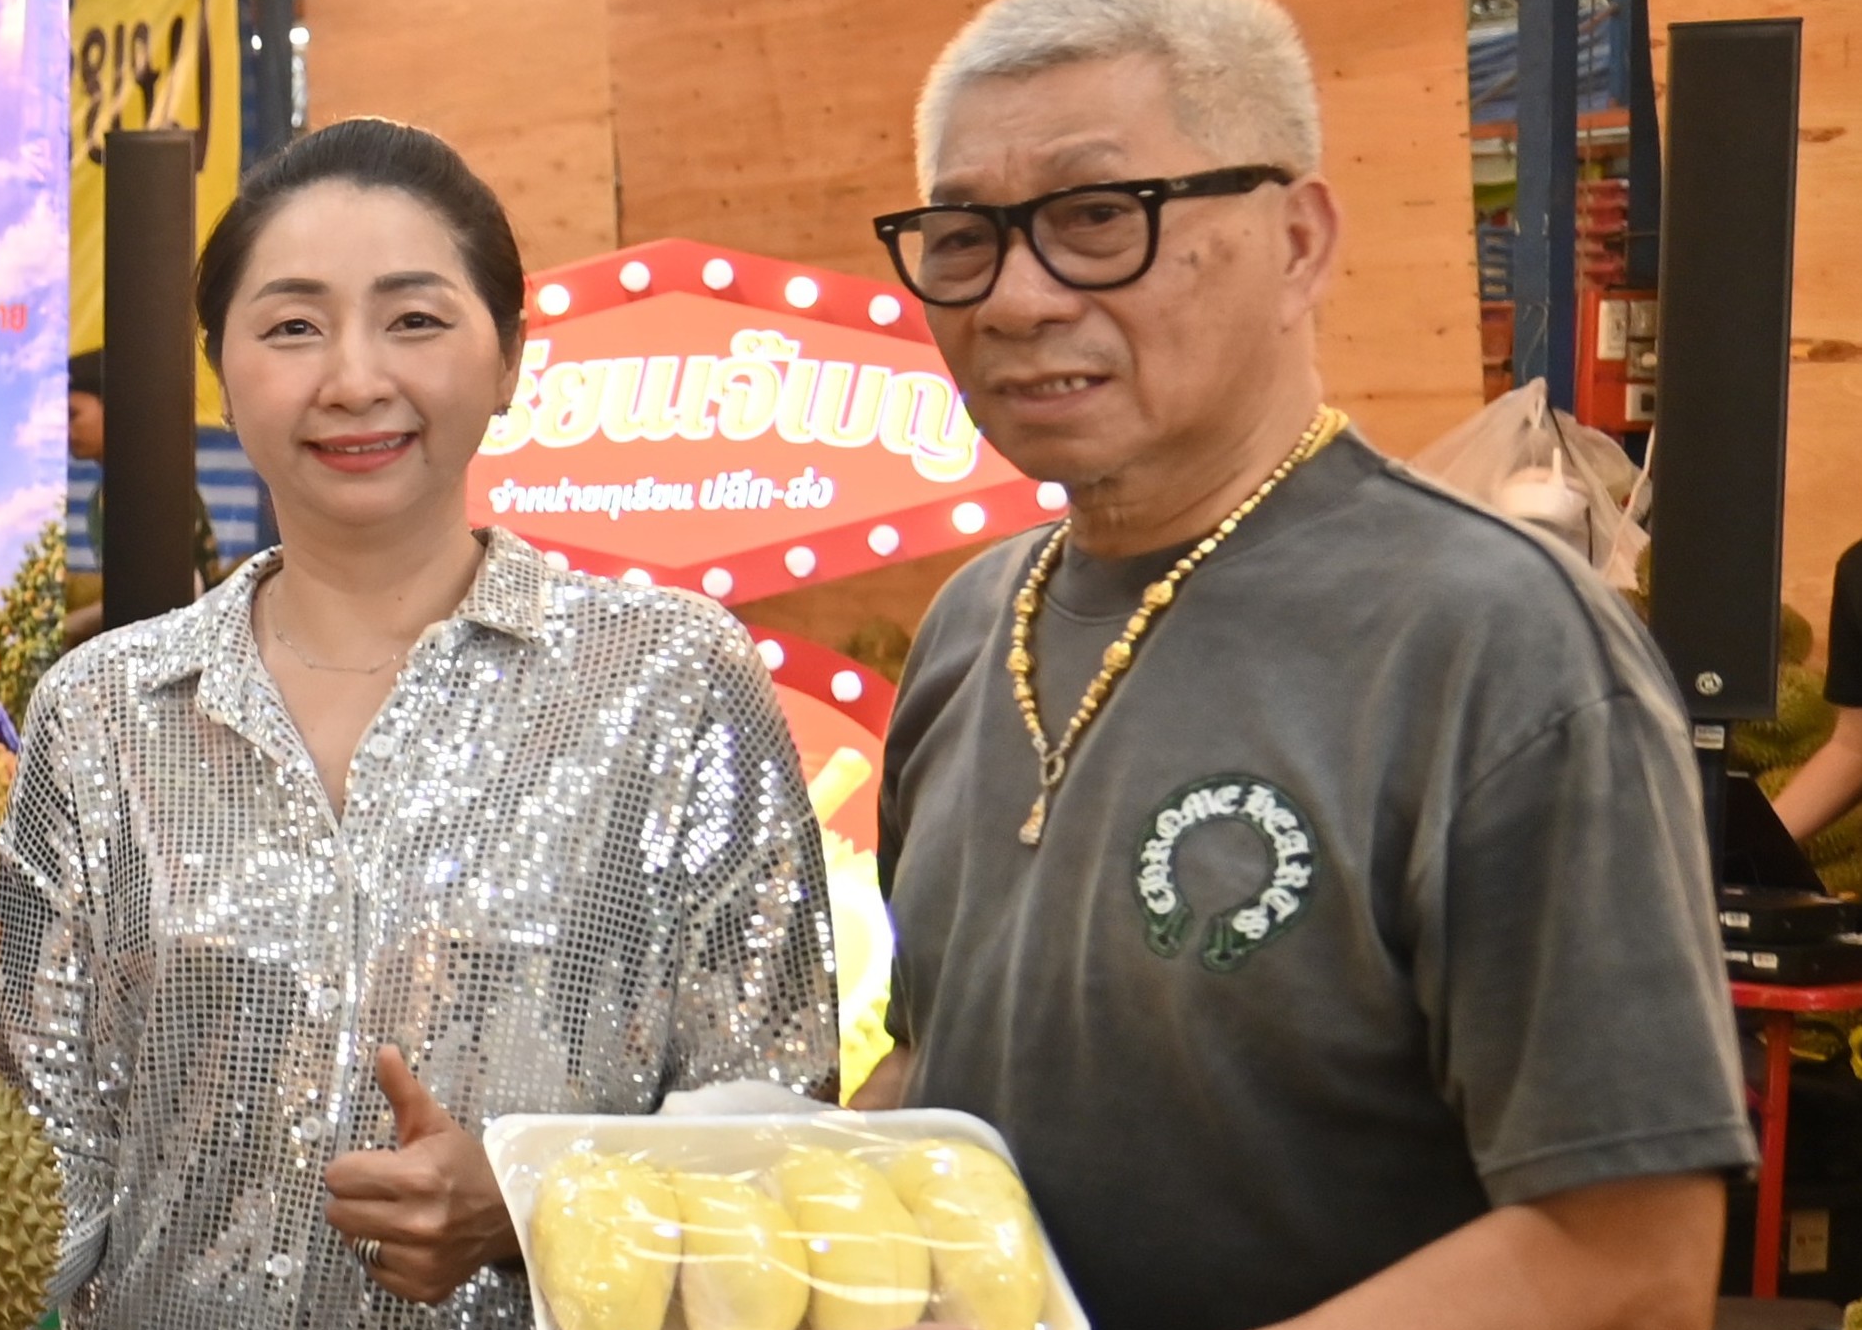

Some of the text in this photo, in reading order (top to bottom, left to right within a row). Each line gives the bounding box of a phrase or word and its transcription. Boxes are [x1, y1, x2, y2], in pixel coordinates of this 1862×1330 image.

[488, 477, 694, 521] จำหน่ายทุเรียน
